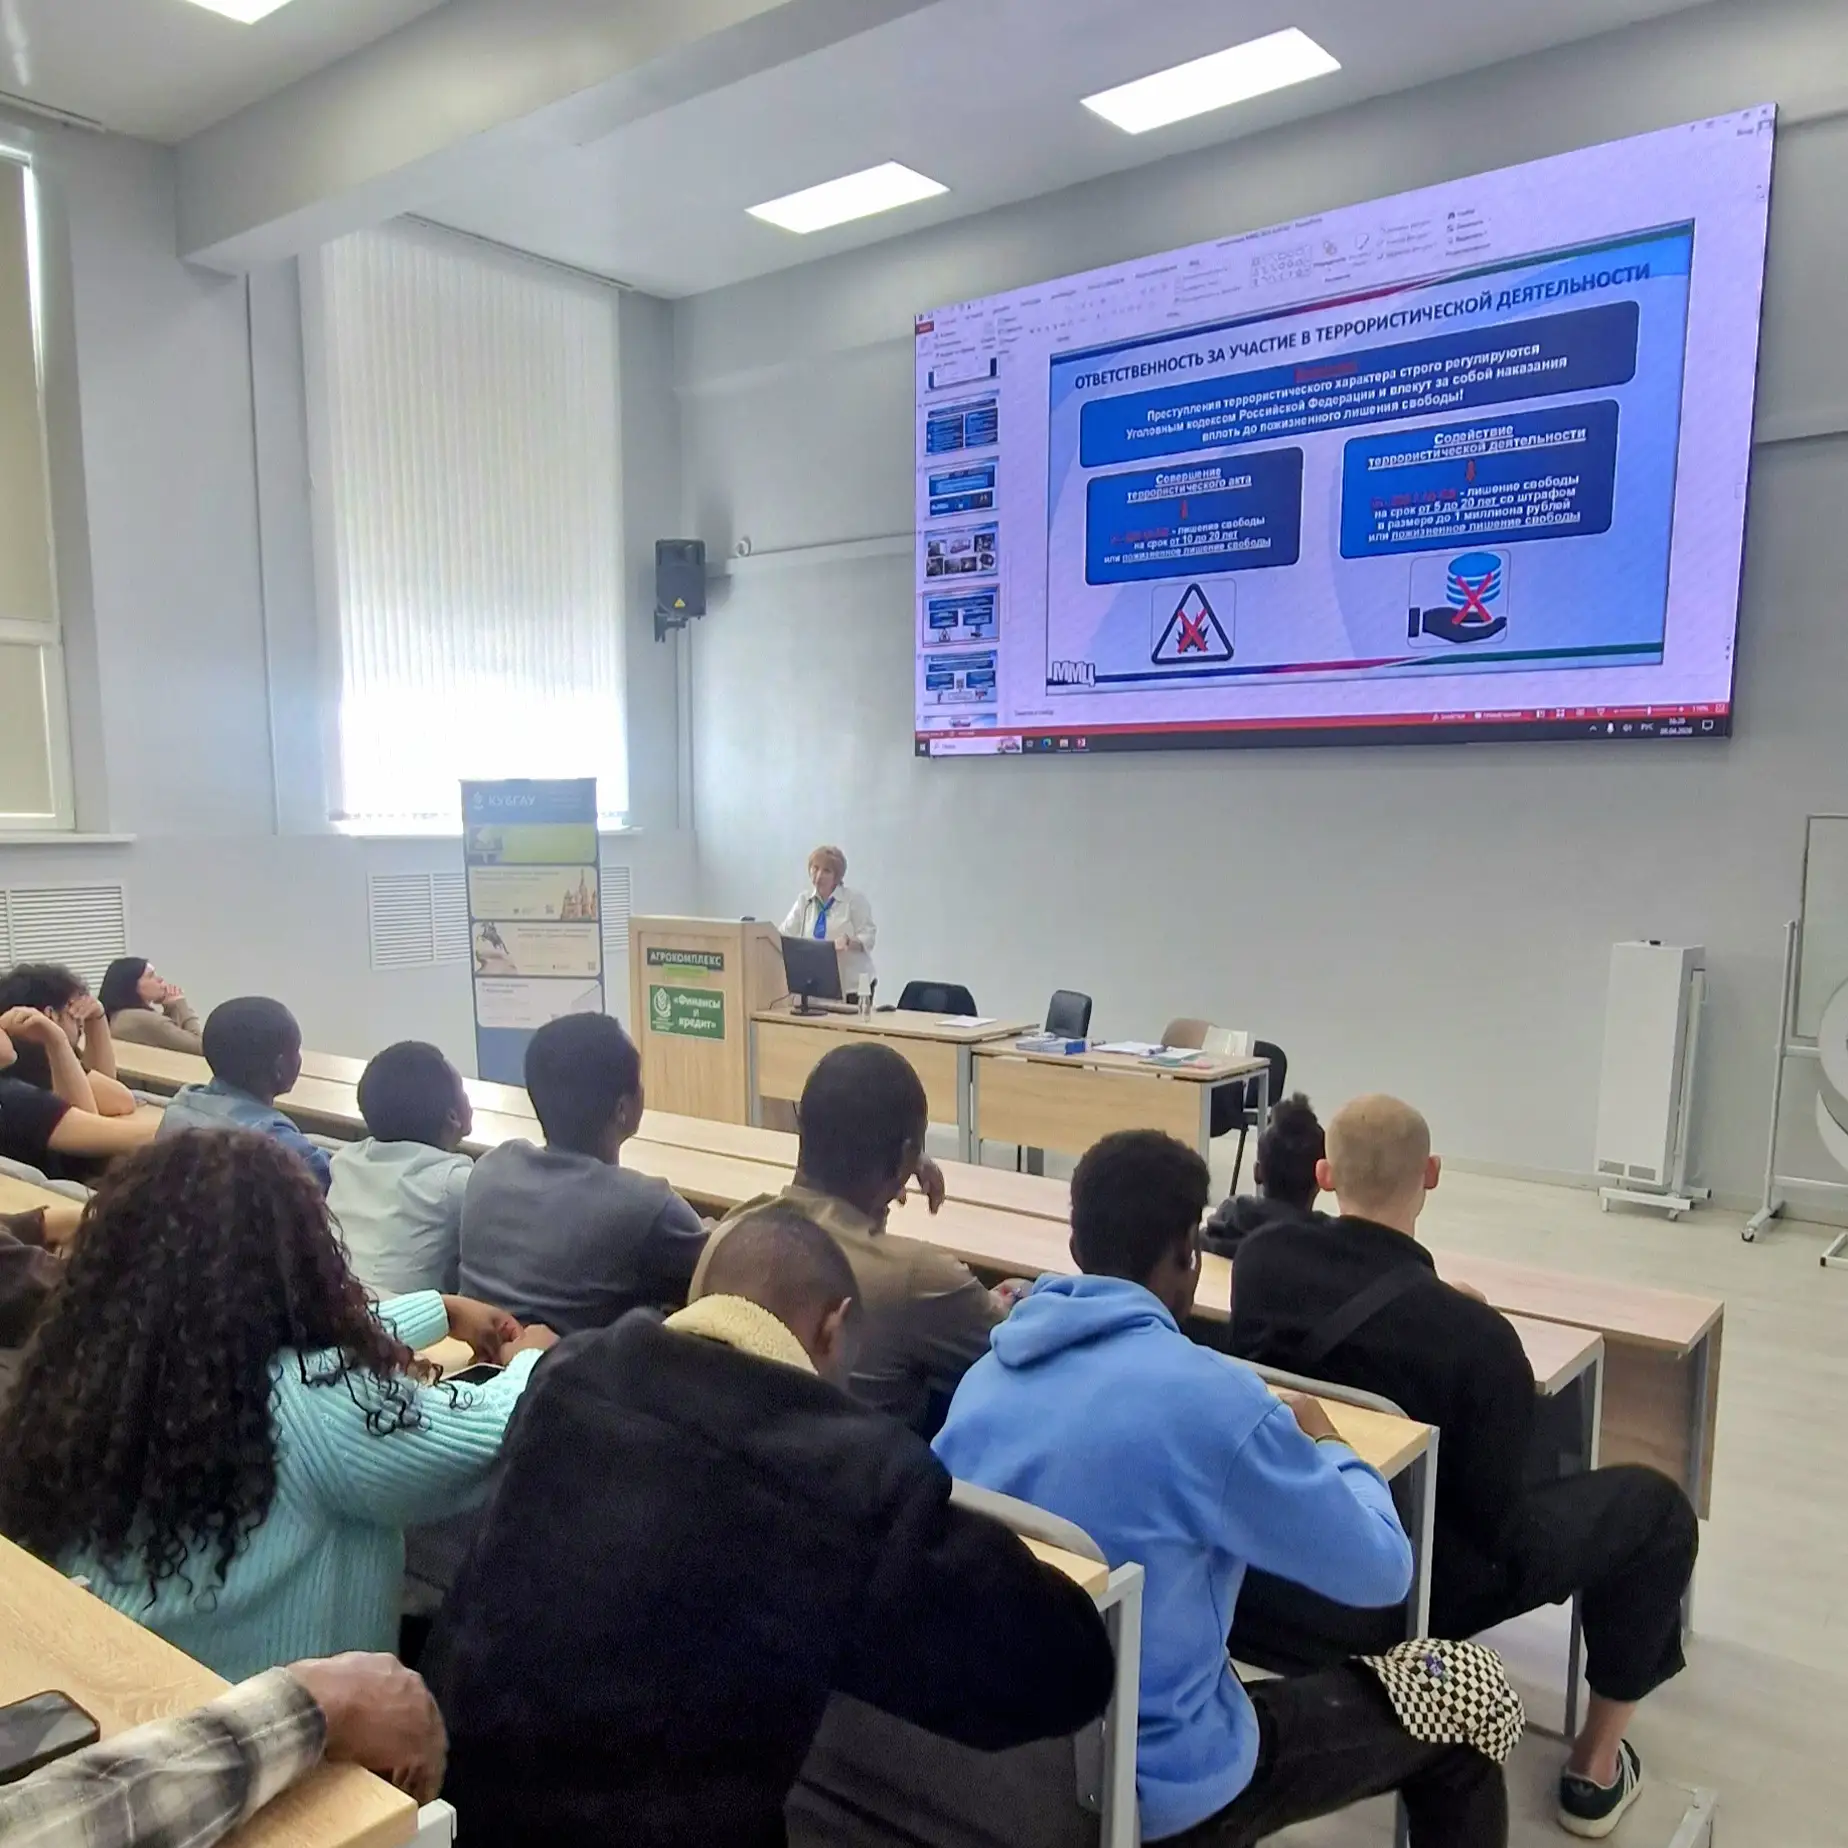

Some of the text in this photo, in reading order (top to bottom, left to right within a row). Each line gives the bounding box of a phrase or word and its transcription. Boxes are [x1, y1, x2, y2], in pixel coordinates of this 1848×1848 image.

[1075, 263, 1651, 389] ОТВЕТСТВЕННОСТЬ ЗА УЧАСТИЕ В ТЕРРОРИСТИЧЕСКОЙ ДЕЯТЕЛЬНОСТИ
[1147, 400, 1222, 421] Преступления
[1223, 380, 1332, 409] террористического
[1335, 370, 1396, 389] характера
[1400, 362, 1442, 380] строго
[1445, 344, 1540, 372] регулируются
[1126, 357, 1568, 440] Уголовным кодексом Российской Федерации и влекут за собой наказания
[1202, 389, 1464, 442] вплоть до пожизненного лишения свободы!
[1434, 426, 1514, 447] Содействие
[1368, 428, 1586, 470] террористической деятельности
[1155, 467, 1222, 486] Совершение
[1228, 474, 1252, 488] акта
[1467, 482, 1520, 497] лишение
[1523, 475, 1579, 490] свободы
[1374, 509, 1387, 518] на
[1390, 506, 1416, 519] срок
[1461, 498, 1475, 509] 20
[1500, 494, 1514, 504] со
[1517, 488, 1576, 503] штрафом
[1221, 516, 1265, 530] свободы
[1435, 513, 1452, 525] до
[1455, 511, 1460, 522] 1
[650, 951, 722, 966] АГРОКОМПЛЕКС
[673, 994, 721, 1009] «Финансы
[678, 1017, 717, 1030] кредит»
